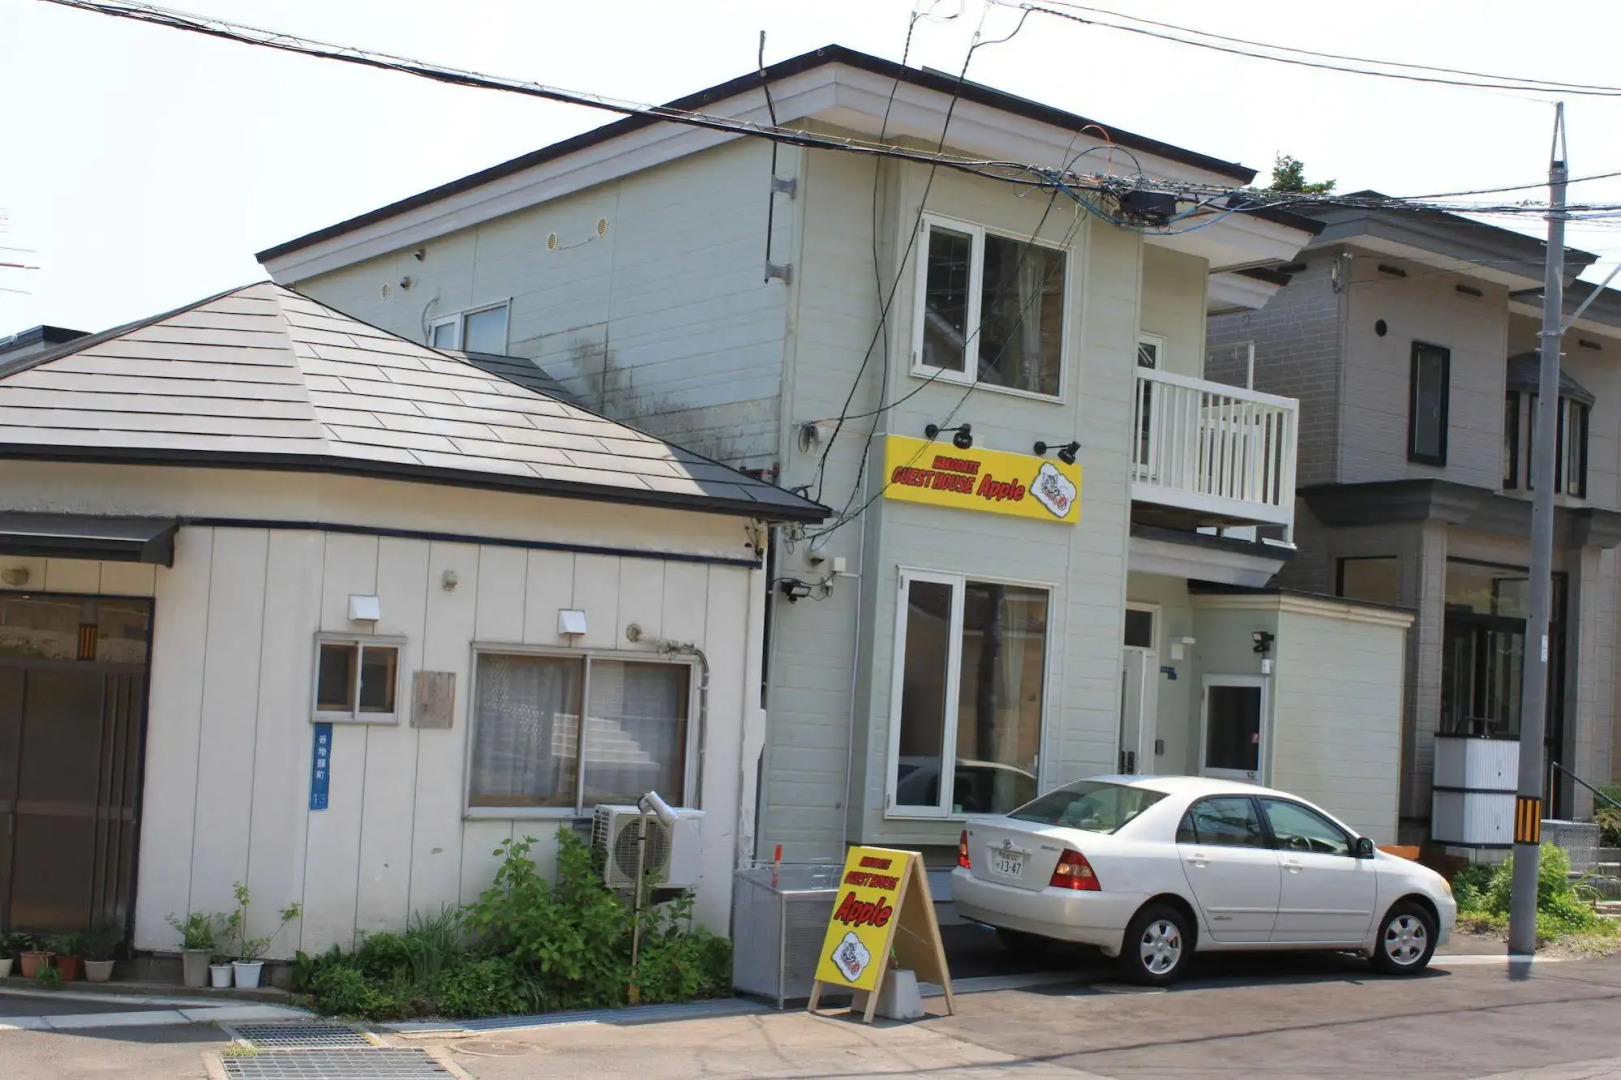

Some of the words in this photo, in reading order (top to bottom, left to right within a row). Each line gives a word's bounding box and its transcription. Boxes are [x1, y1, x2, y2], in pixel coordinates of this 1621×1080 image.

[931, 455, 981, 476] HAKODATE
[891, 466, 935, 488] GUEST
[932, 472, 976, 494] HOUSE
[976, 474, 1026, 502] Apple
[833, 891, 893, 928] Apple
